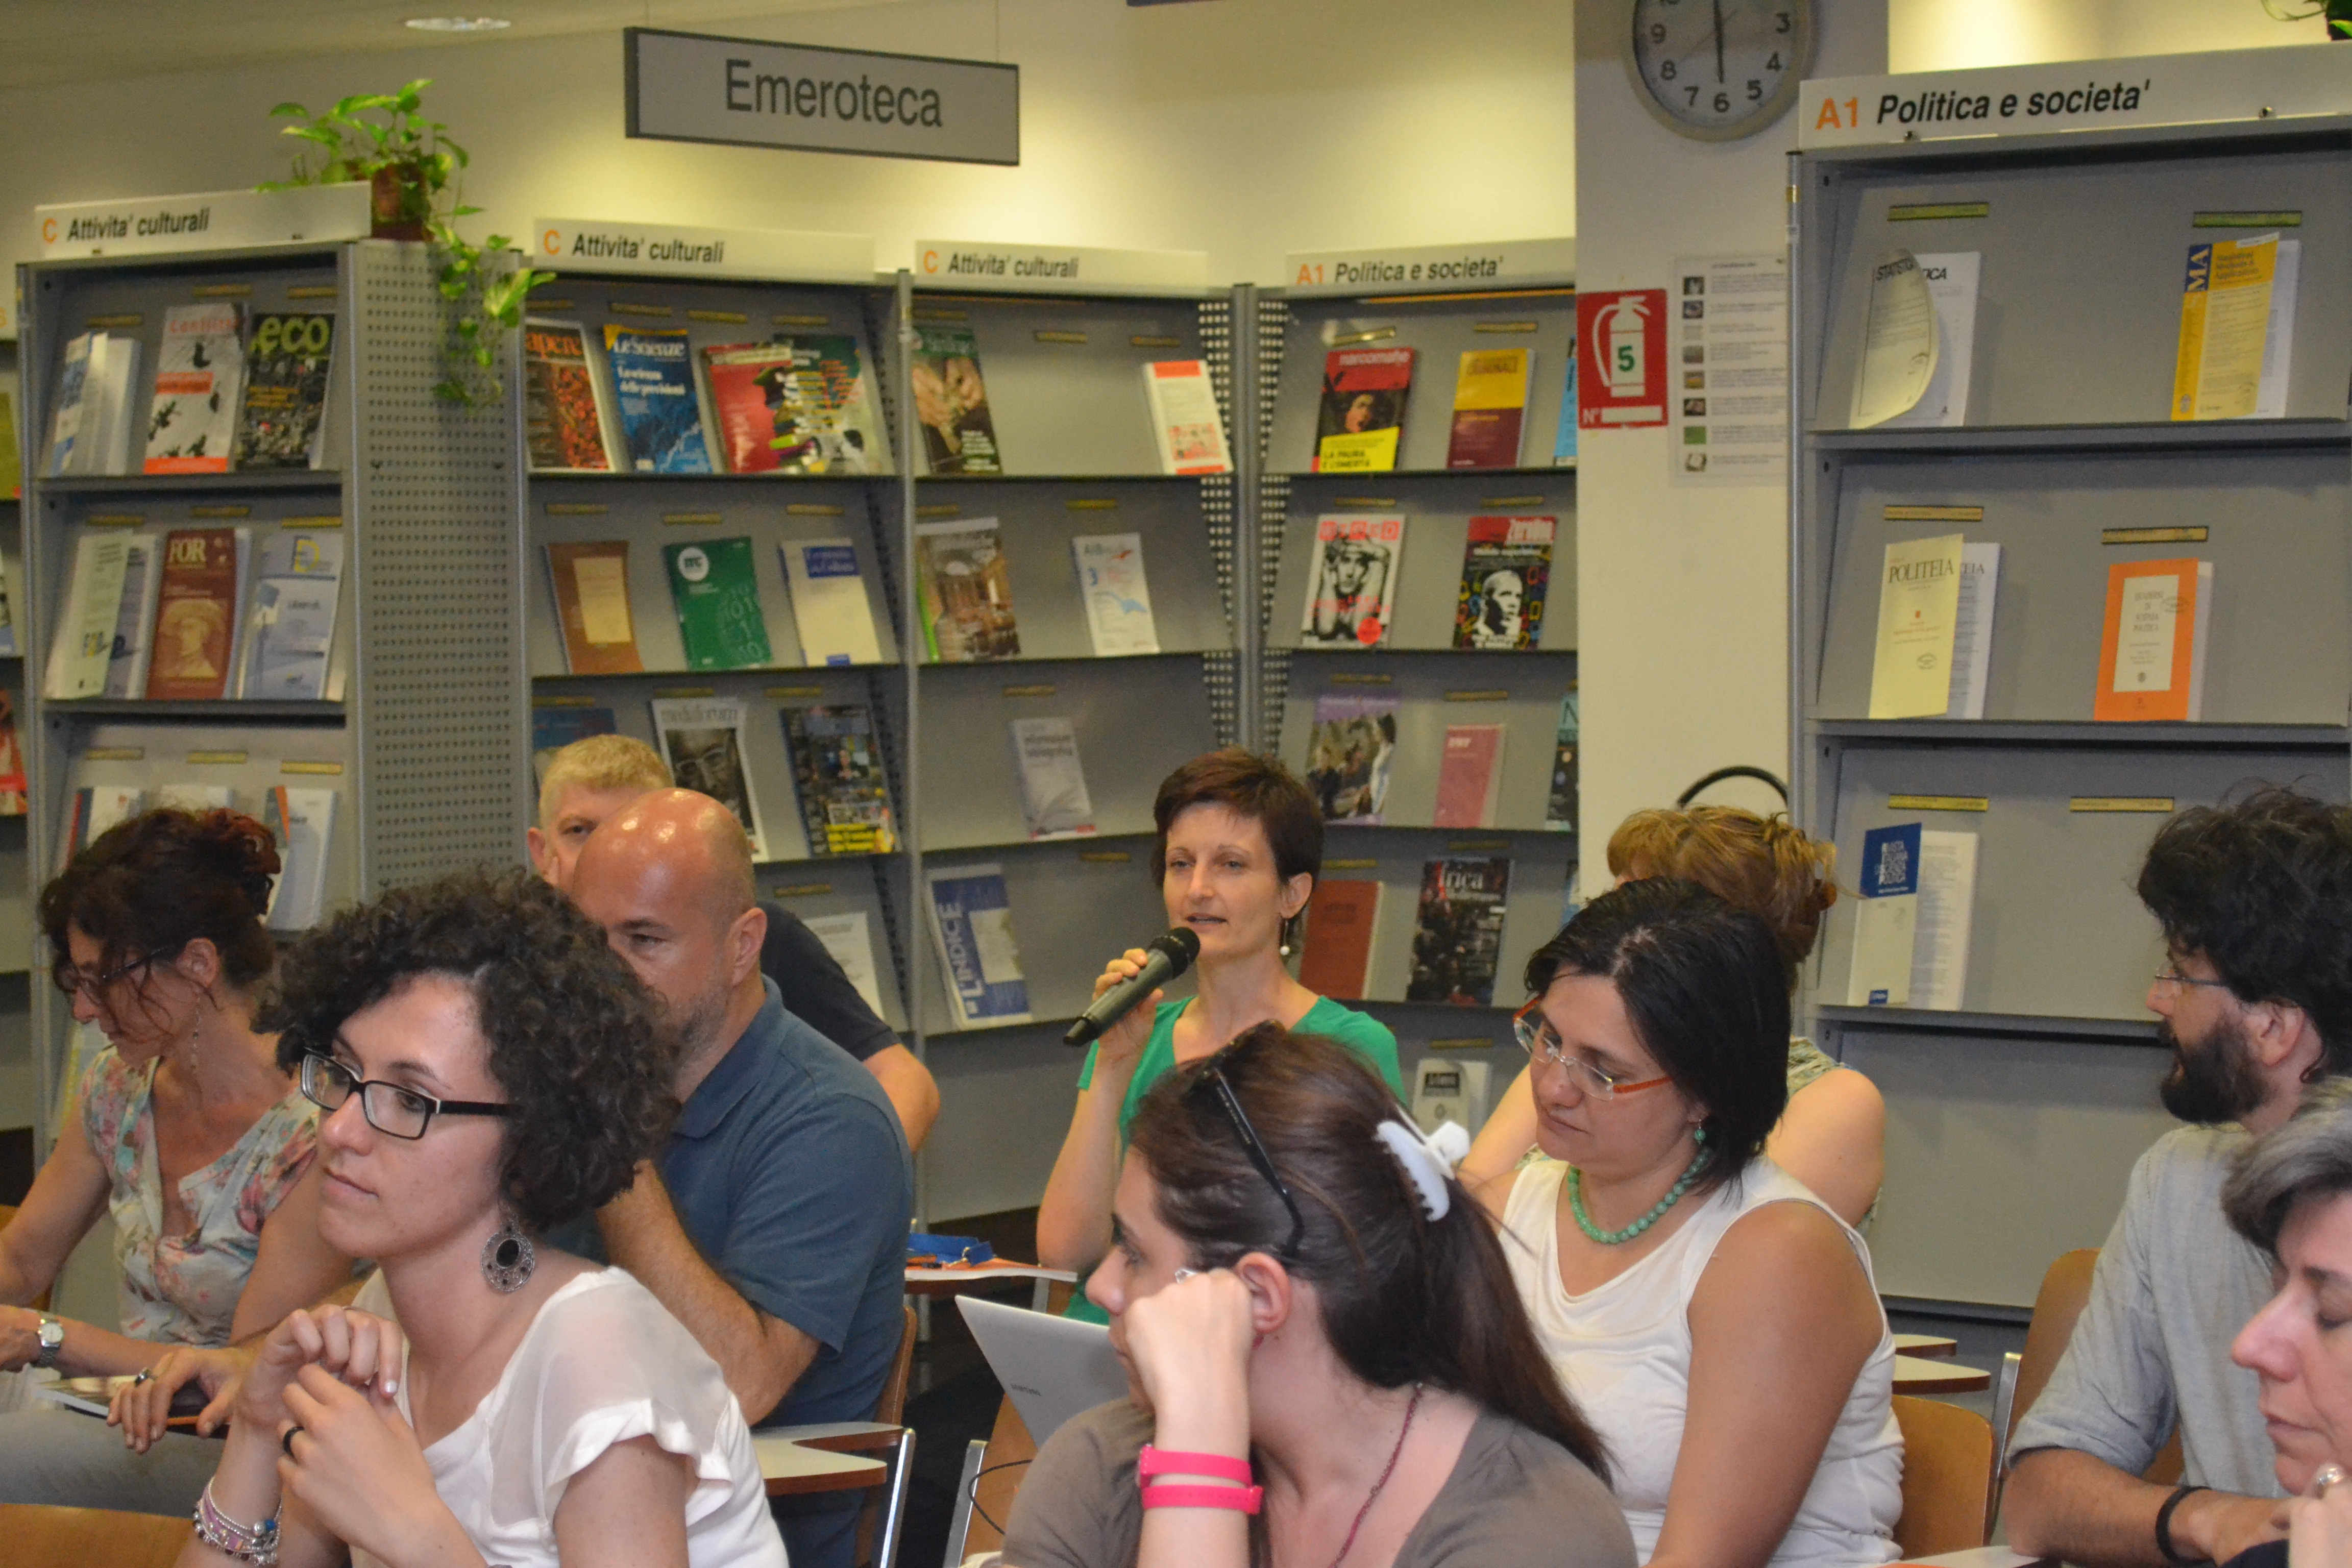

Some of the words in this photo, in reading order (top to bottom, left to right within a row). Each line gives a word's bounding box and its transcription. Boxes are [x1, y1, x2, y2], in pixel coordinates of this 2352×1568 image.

[1650, 23, 1667, 44] 9
[1776, 12, 1791, 34] 3
[1659, 60, 1677, 81] 8
[1766, 51, 1782, 72] 4
[725, 59, 943, 128] Emeroteca
[1684, 85, 1700, 107] 7
[1713, 92, 1730, 113] 6
[1747, 79, 1763, 101] 5
[1815, 96, 1859, 130] A1
[1877, 92, 1991, 125] Politica
[1999, 95, 2018, 117] e
[2027, 79, 2151, 116] societa'
[42, 218, 57, 243] C
[67, 213, 133, 242] Attivita'
[136, 207, 210, 237] culturali
[544, 229, 561, 256] C
[572, 233, 644, 259] Attivita'
[649, 239, 725, 263] culturali
[923, 251, 939, 274] C
[948, 253, 1010, 277] Attivita'
[1014, 256, 1079, 279] culturali
[1296, 263, 1325, 285] A1
[1334, 260, 1405, 283] Politica
[1410, 263, 1422, 282] e
[1427, 256, 1504, 280] societa'
[258, 316, 330, 354] eco
[1617, 345, 1635, 372] 5
[1889, 558, 1954, 584] POLITEIA
